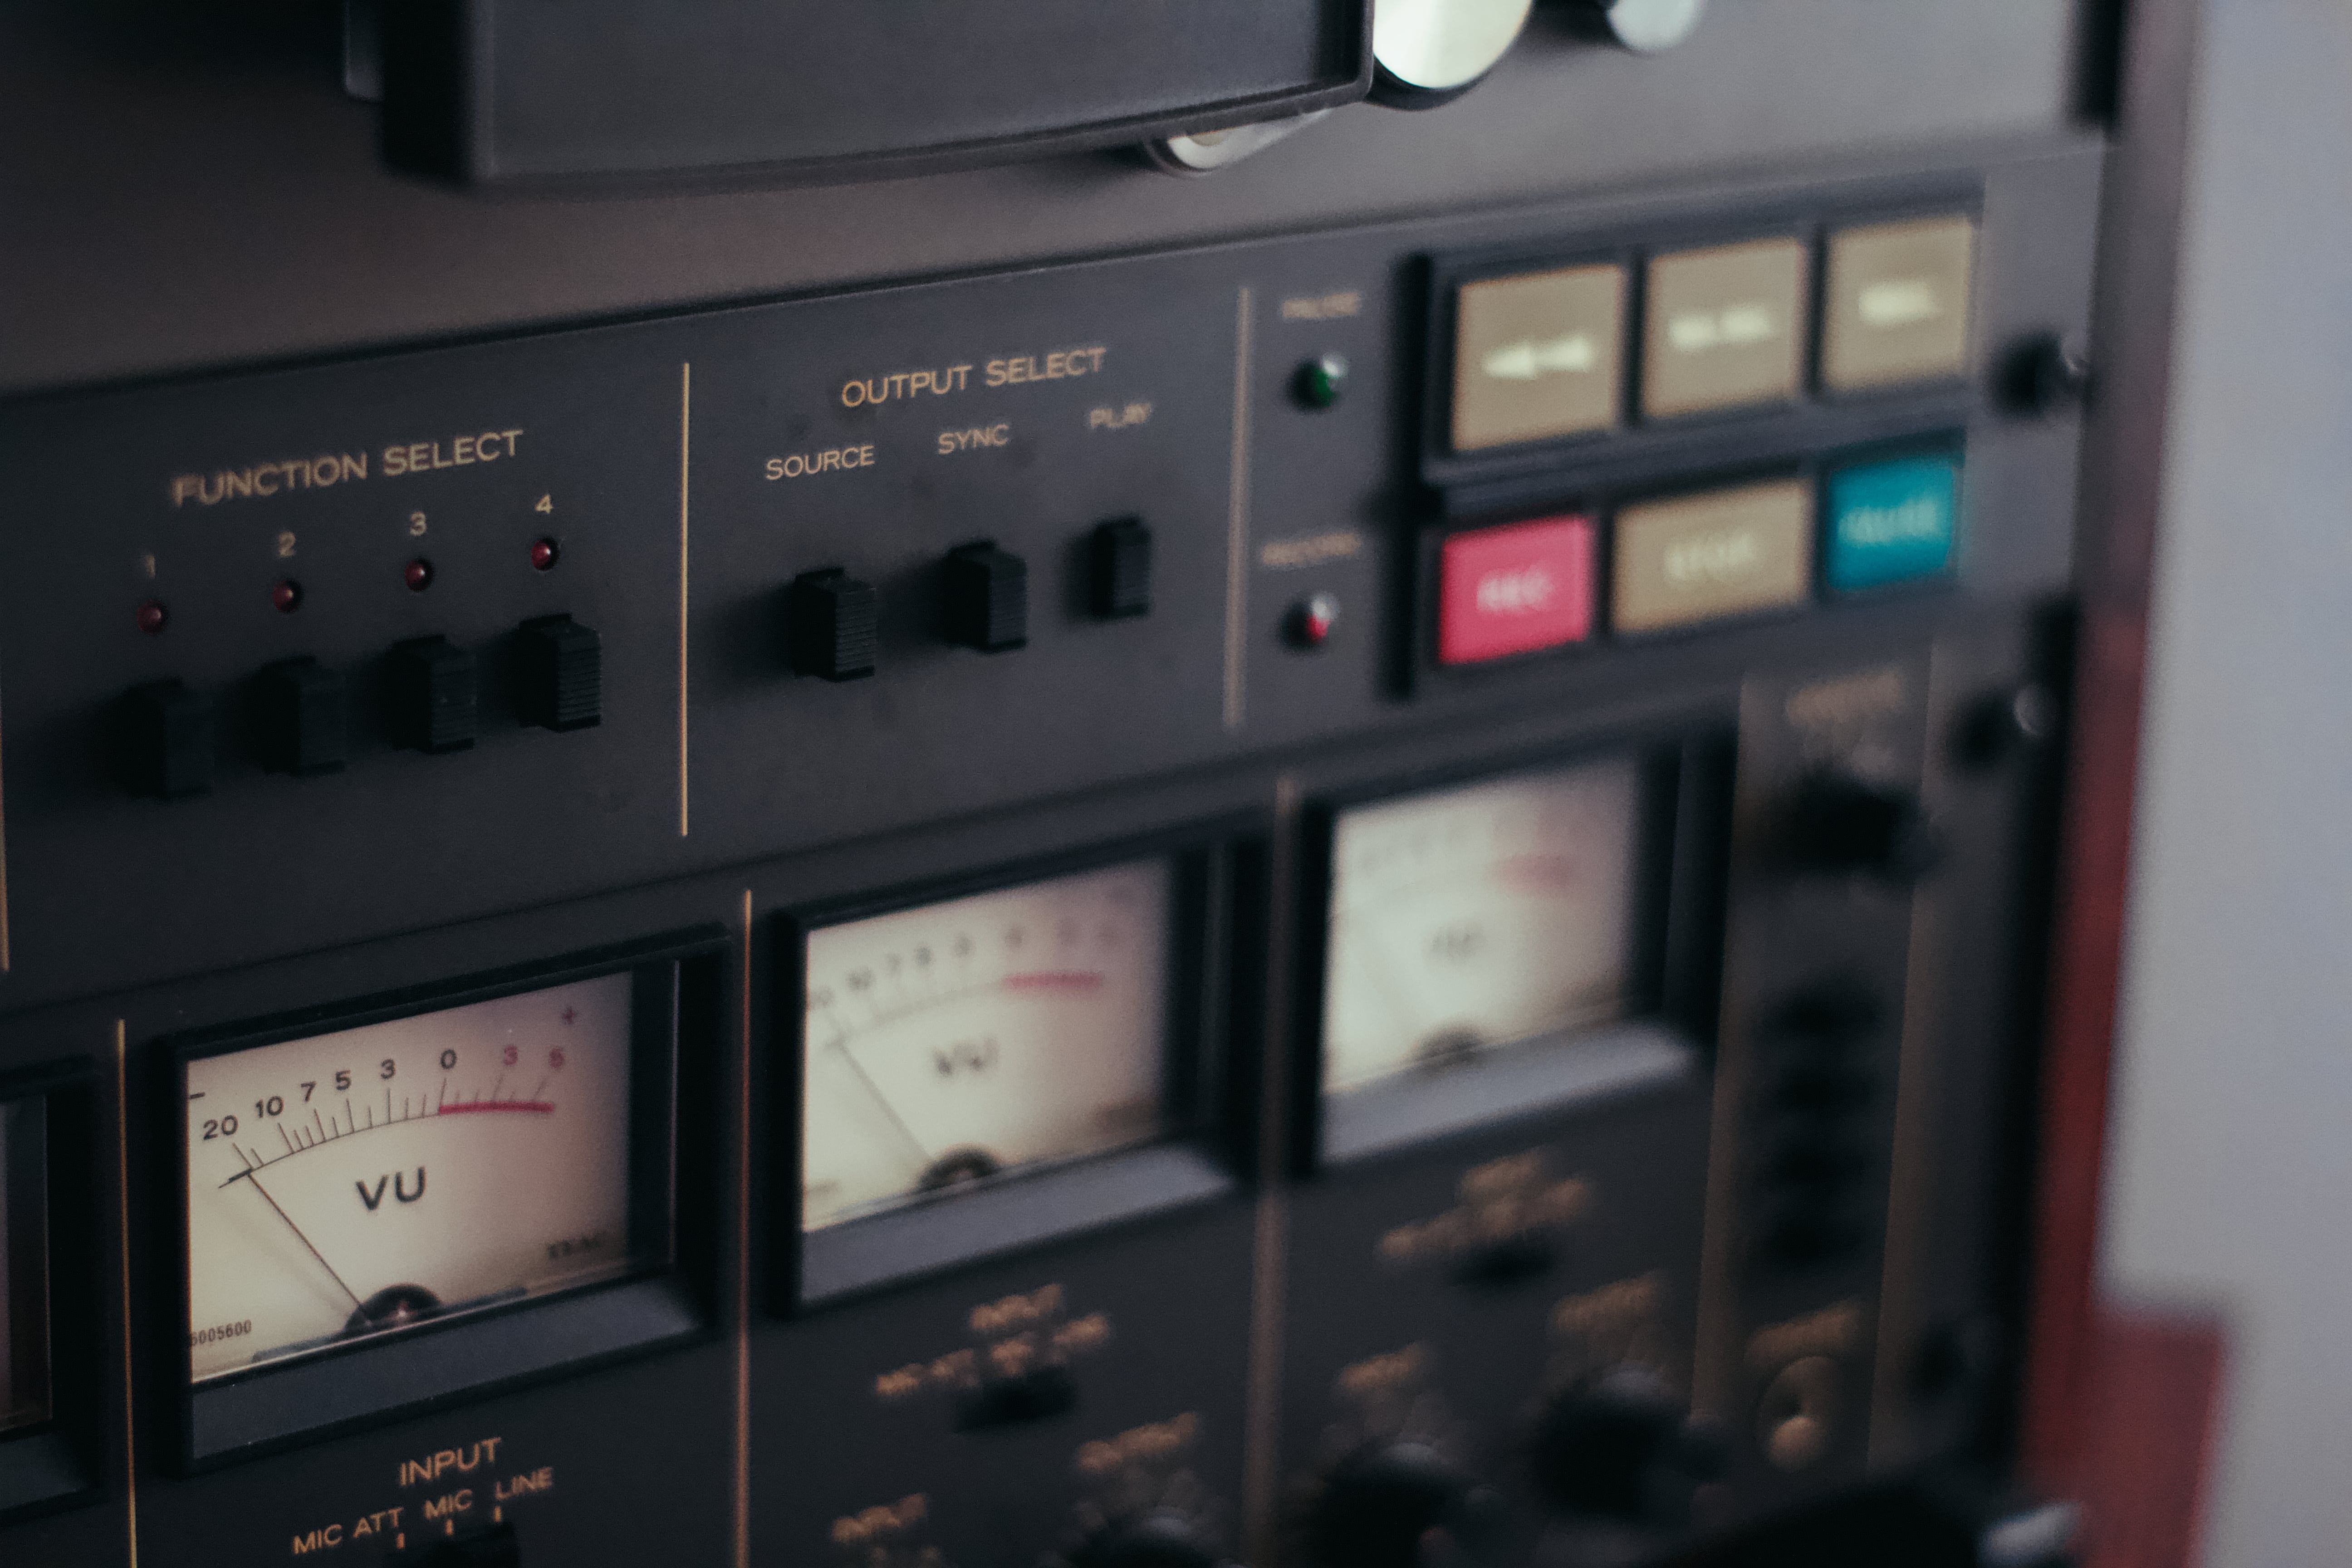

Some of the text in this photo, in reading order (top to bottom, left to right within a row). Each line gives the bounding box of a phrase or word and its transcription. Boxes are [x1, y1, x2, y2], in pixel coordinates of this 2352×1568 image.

[841, 347, 1107, 408] OUTPUT SELECT
[938, 423, 1009, 455] SYNC
[1089, 402, 1152, 429] PLAY
[171, 429, 524, 506] FUNCTION SELECT
[765, 445, 875, 481] SOURCE
[278, 531, 296, 559] 2
[409, 511, 427, 537] 3
[534, 494, 554, 516] 4
[202, 1114, 239, 1141] 20
[255, 1095, 284, 1118] 10
[300, 1080, 317, 1102] 7
[335, 1069, 352, 1091] 5
[380, 1058, 396, 1081] 3
[439, 1048, 458, 1070] 0
[502, 1044, 519, 1067] 3
[355, 1166, 426, 1212] VU
[399, 1436, 501, 1486] INPUT
[495, 1466, 553, 1501] LINE
[423, 1489, 473, 1520] MIC
[292, 1507, 404, 1555] MIC ATT
